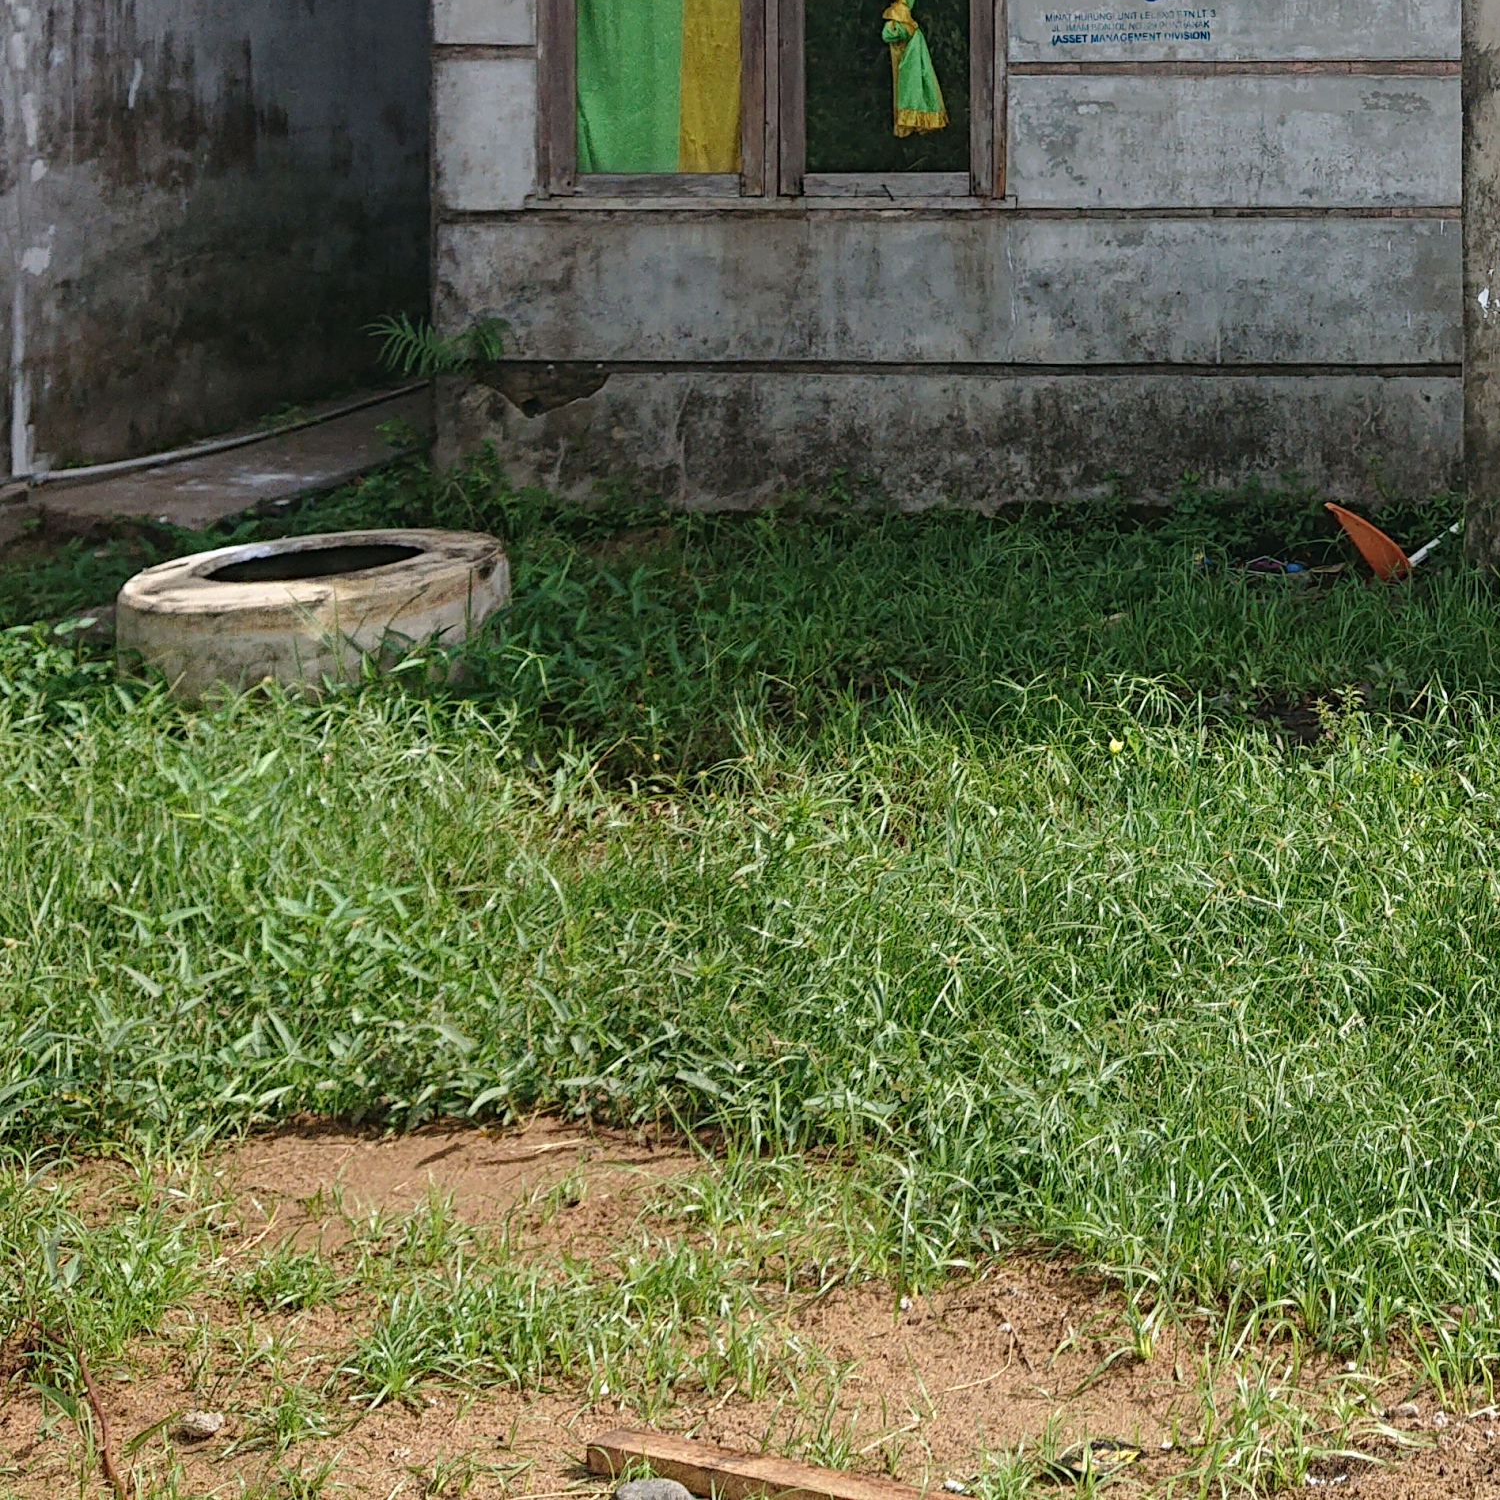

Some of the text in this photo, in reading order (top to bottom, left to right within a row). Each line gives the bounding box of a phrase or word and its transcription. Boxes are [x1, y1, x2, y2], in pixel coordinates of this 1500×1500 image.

[1045, 12, 1072, 22] MINAT
[1118, 12, 1137, 20] UNIT
[1210, 10, 1216, 18] 3
[1052, 31, 1210, 46] (ASSET MANAGEMENT DIVISION)
